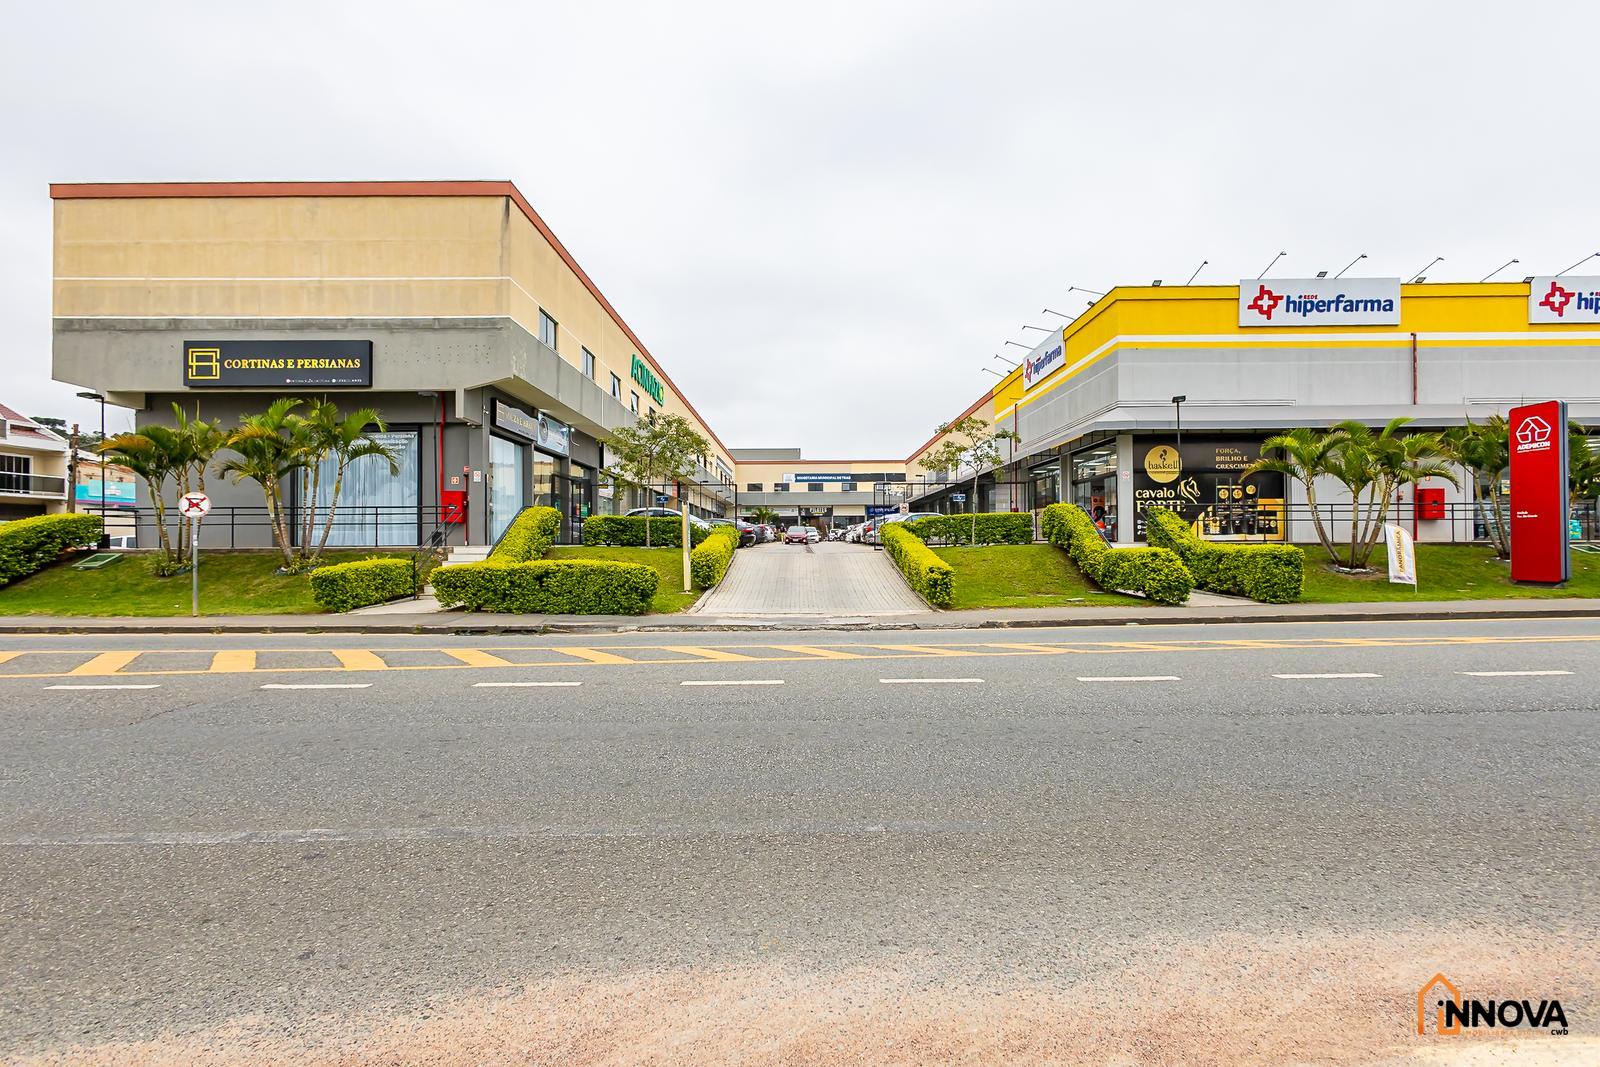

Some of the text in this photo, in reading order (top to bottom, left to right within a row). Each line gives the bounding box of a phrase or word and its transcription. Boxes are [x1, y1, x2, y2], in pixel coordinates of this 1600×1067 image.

[1285, 294, 1394, 317] hiperfarma
[224, 359, 361, 369] CORTINAS E PERSIANAS
[1031, 345, 1062, 375] hiperfarma
[1148, 460, 1178, 470] haskell
[1135, 487, 1175, 499] cavalo
